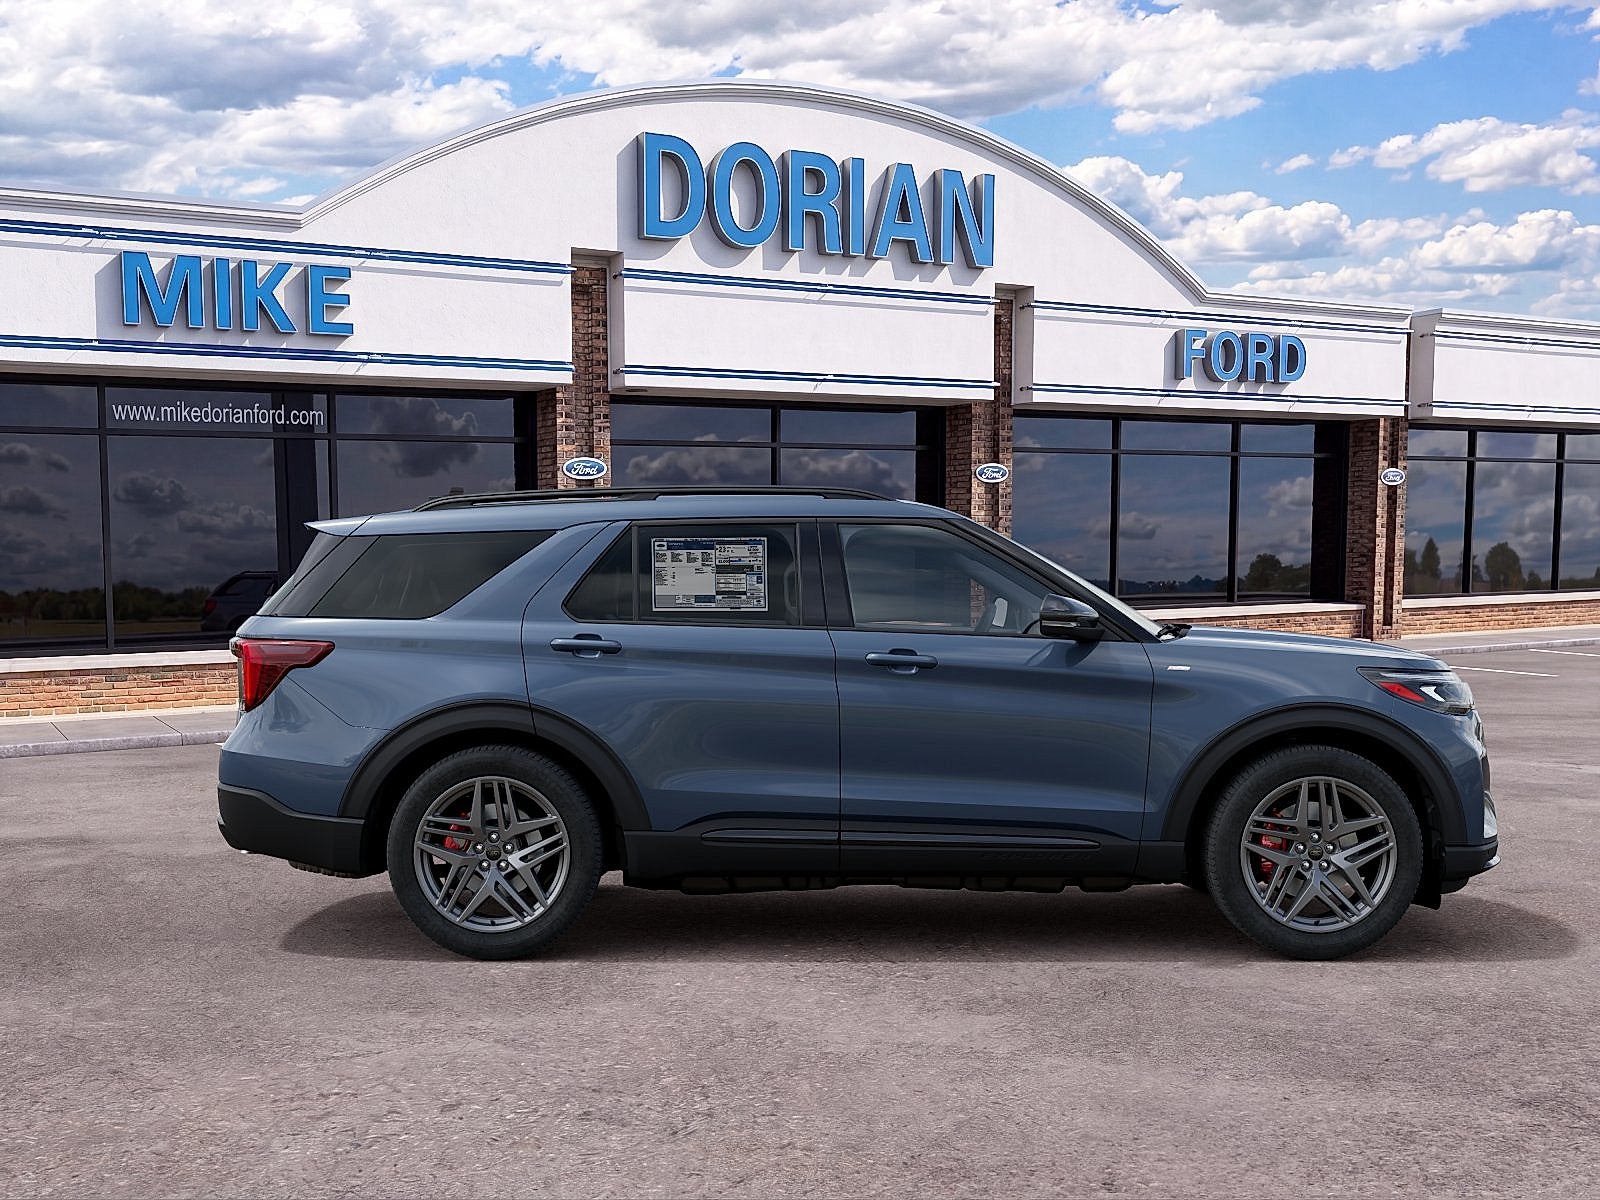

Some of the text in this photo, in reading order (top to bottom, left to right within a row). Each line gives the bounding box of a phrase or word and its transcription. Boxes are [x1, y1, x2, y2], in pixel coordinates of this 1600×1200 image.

[638, 132, 995, 268] DORIAN
[120, 250, 355, 337] MIKE
[1176, 328, 1307, 384] FORD
[112, 401, 324, 425] www.mikedorianford.com
